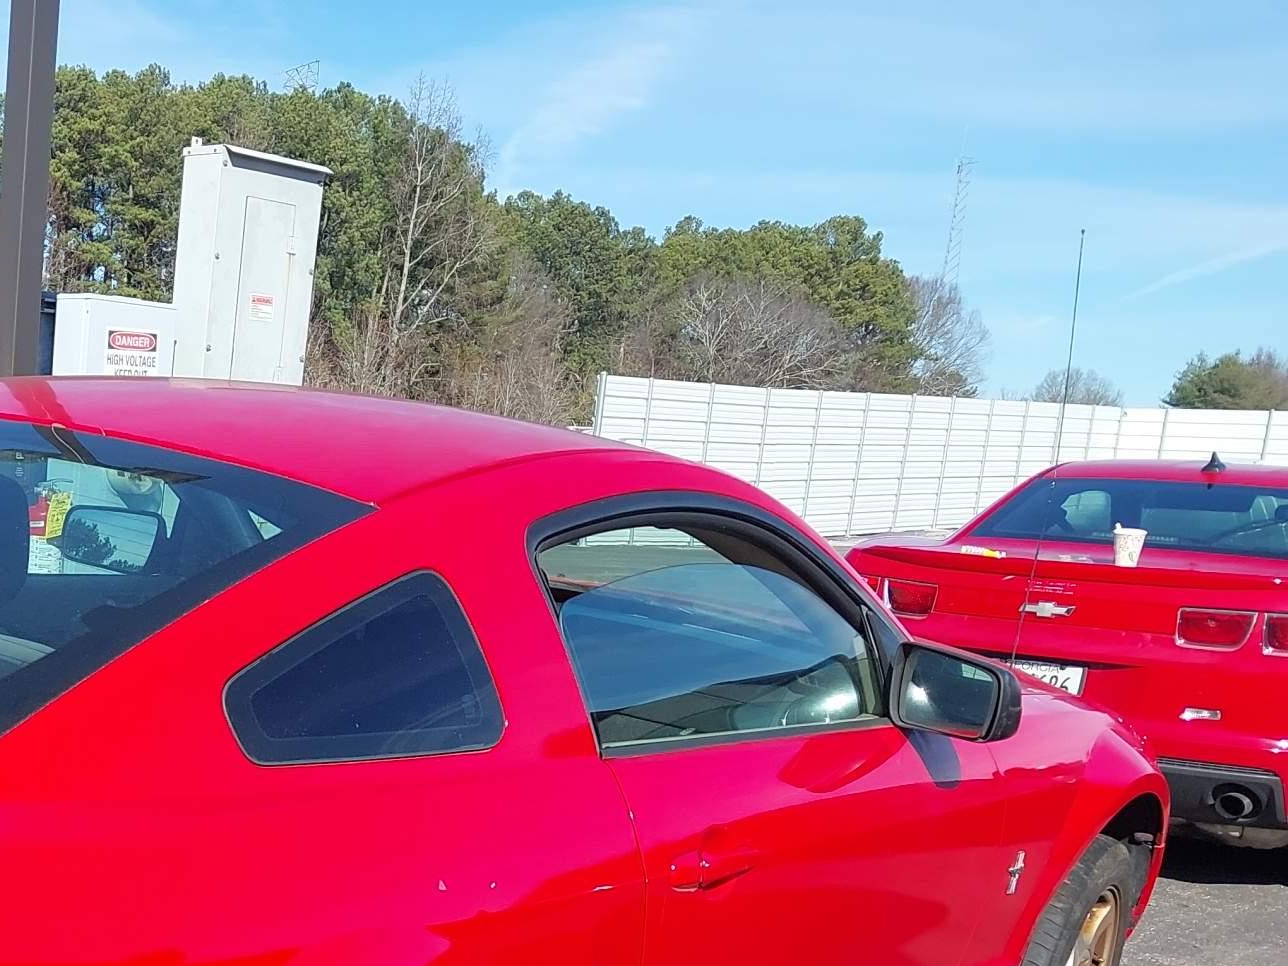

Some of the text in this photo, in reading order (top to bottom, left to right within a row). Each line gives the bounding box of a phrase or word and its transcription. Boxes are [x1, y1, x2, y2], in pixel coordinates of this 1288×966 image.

[115, 335, 150, 348] DANGER
[107, 353, 156, 368] HIGH VOLTAGE
